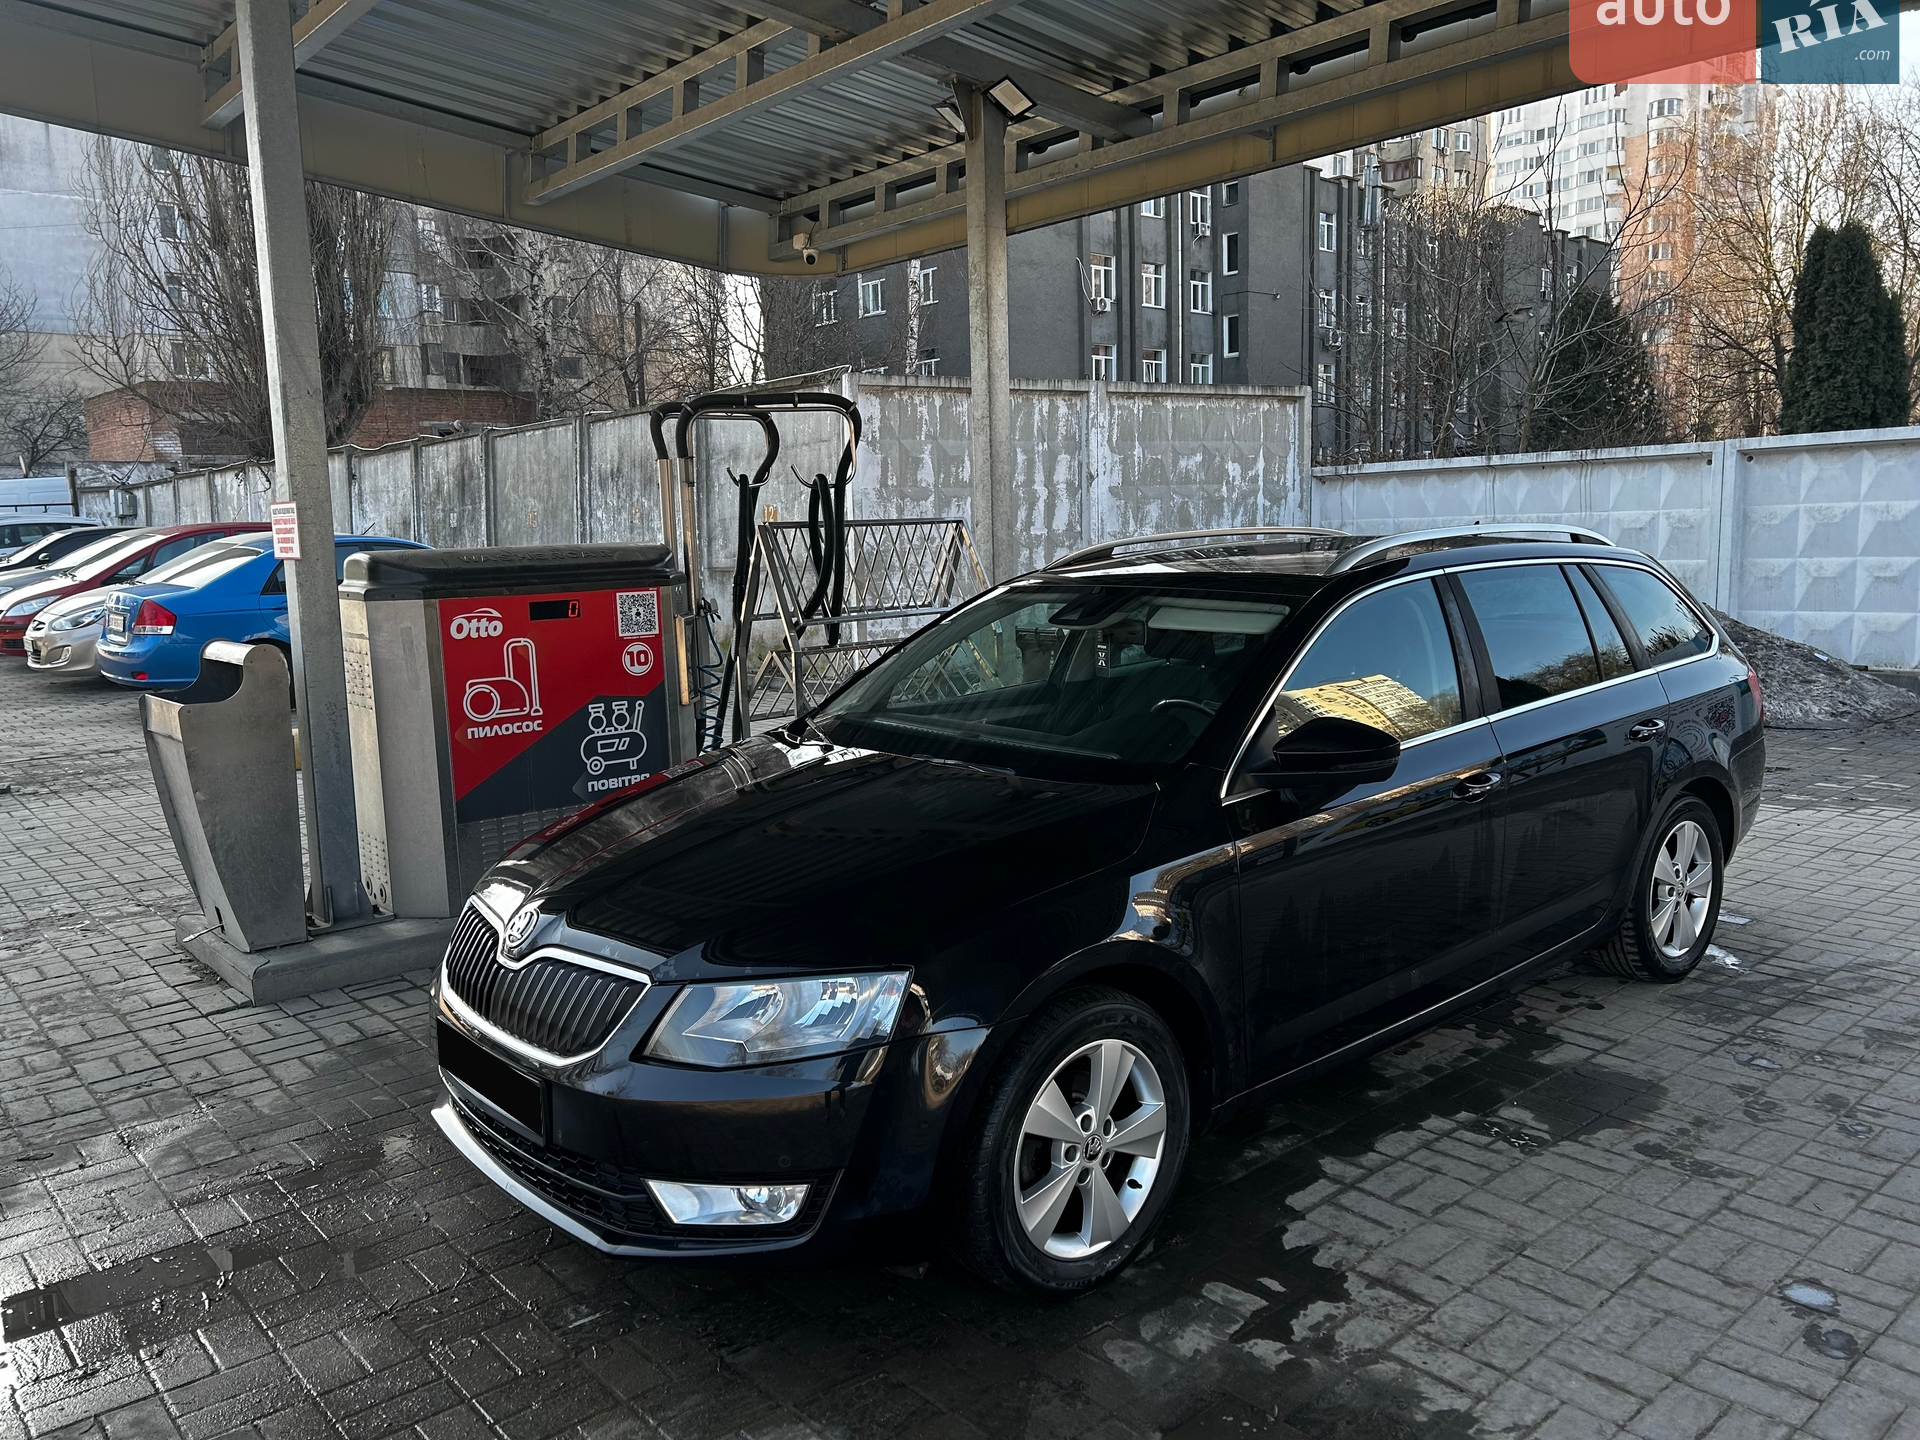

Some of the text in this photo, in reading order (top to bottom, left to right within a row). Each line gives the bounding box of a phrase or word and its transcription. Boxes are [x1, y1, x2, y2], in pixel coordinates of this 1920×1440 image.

[568, 600, 579, 618] 0
[450, 617, 503, 640] Otto
[626, 649, 650, 668] 10
[467, 719, 543, 740] ПИЛОСОС
